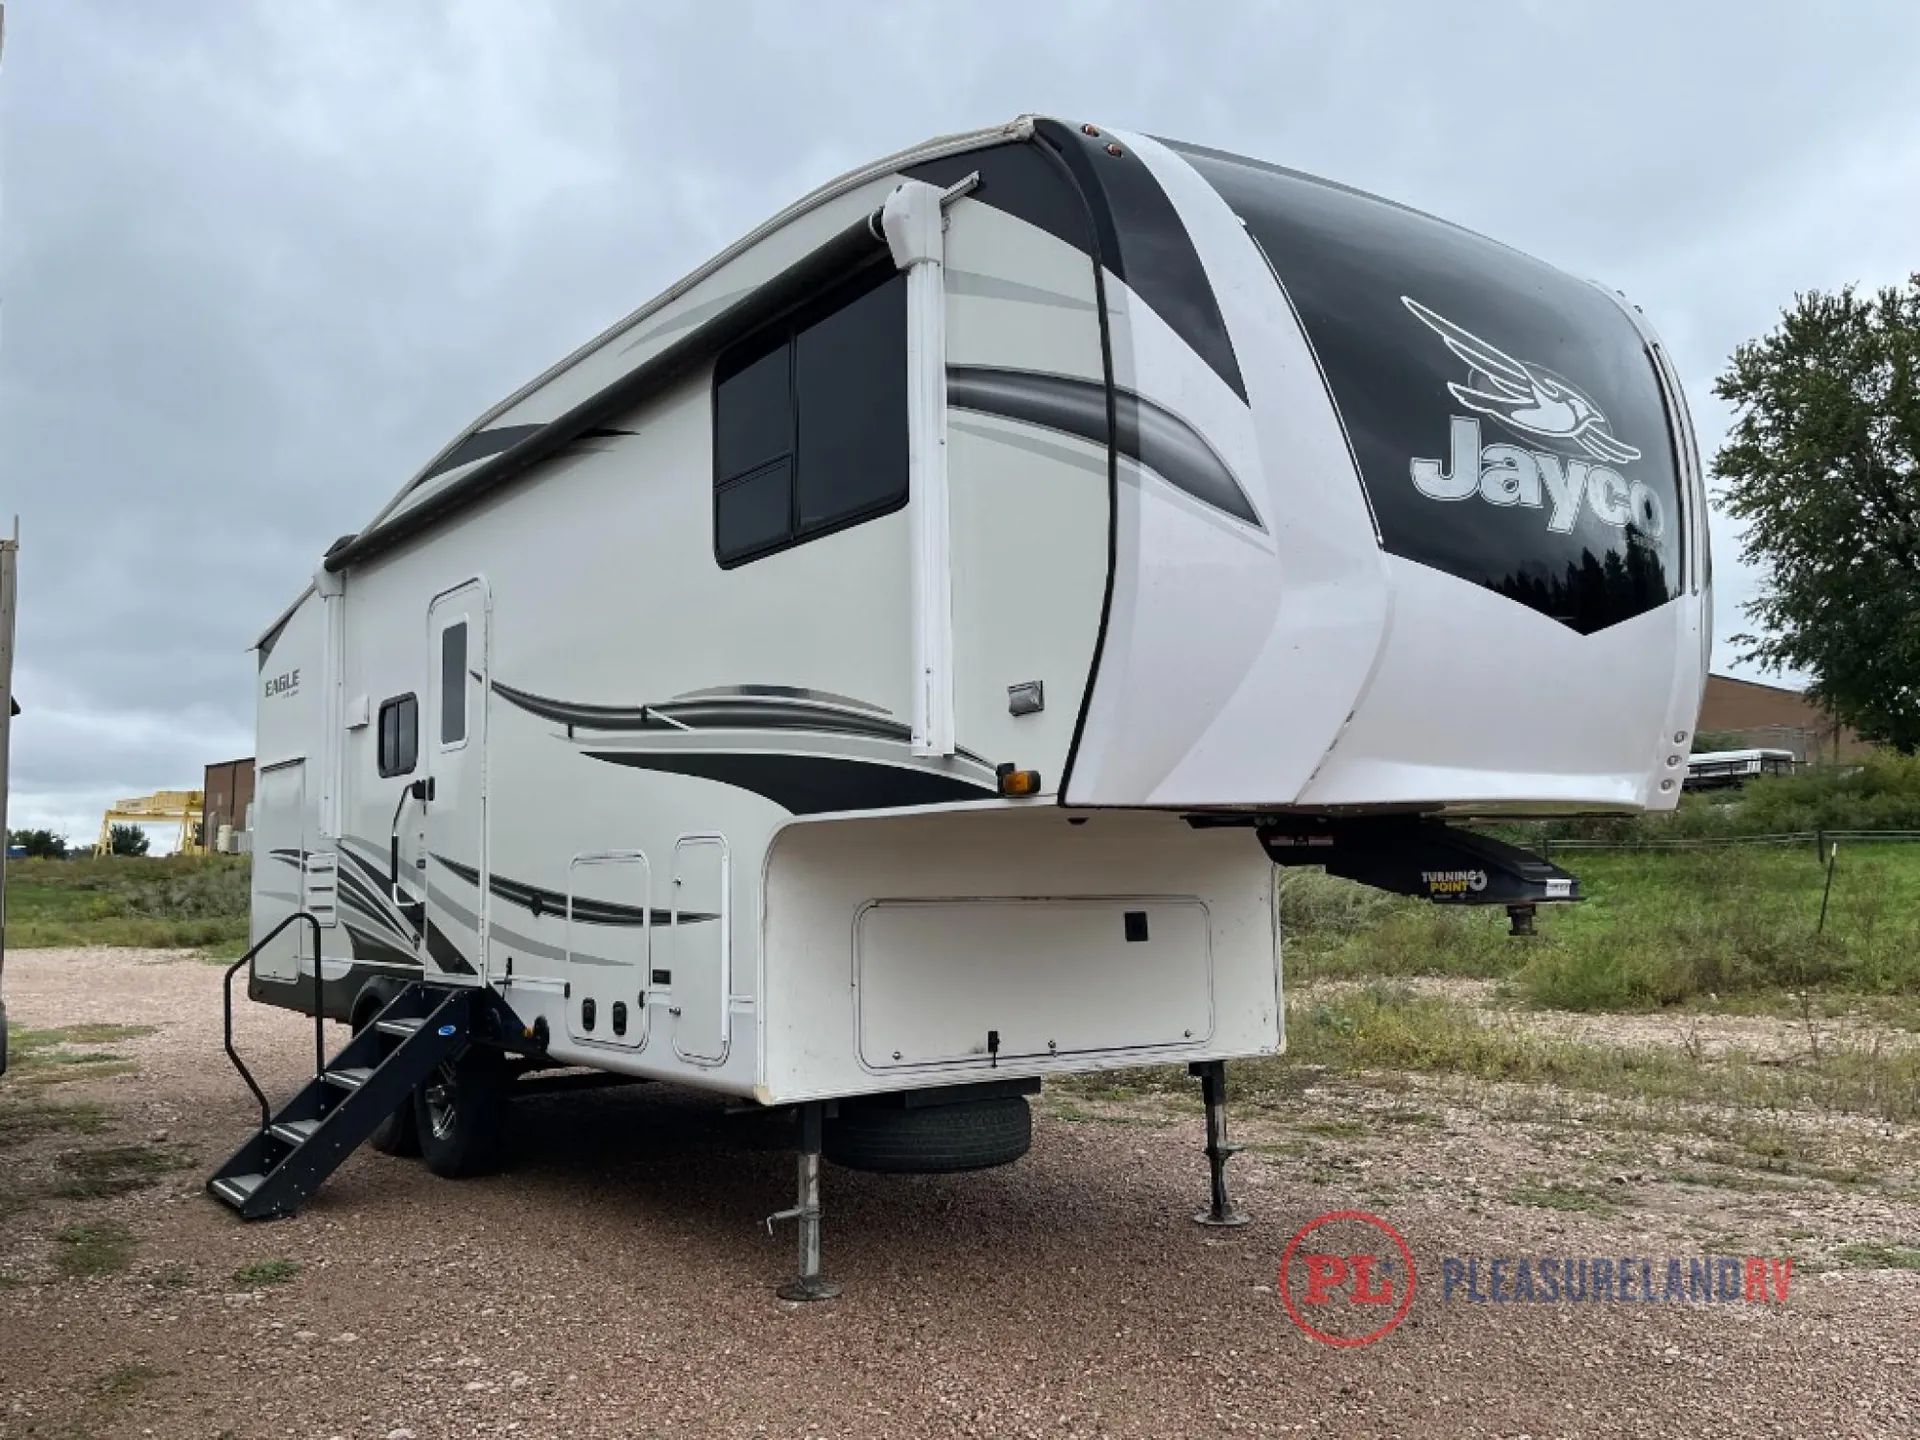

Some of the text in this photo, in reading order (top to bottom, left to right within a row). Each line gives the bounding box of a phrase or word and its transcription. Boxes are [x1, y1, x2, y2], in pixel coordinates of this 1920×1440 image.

[1410, 415, 1664, 537] Jayco
[265, 669, 301, 698] EAGLE
[1421, 871, 1477, 883] TURNING
[1431, 880, 1468, 892] POINT
